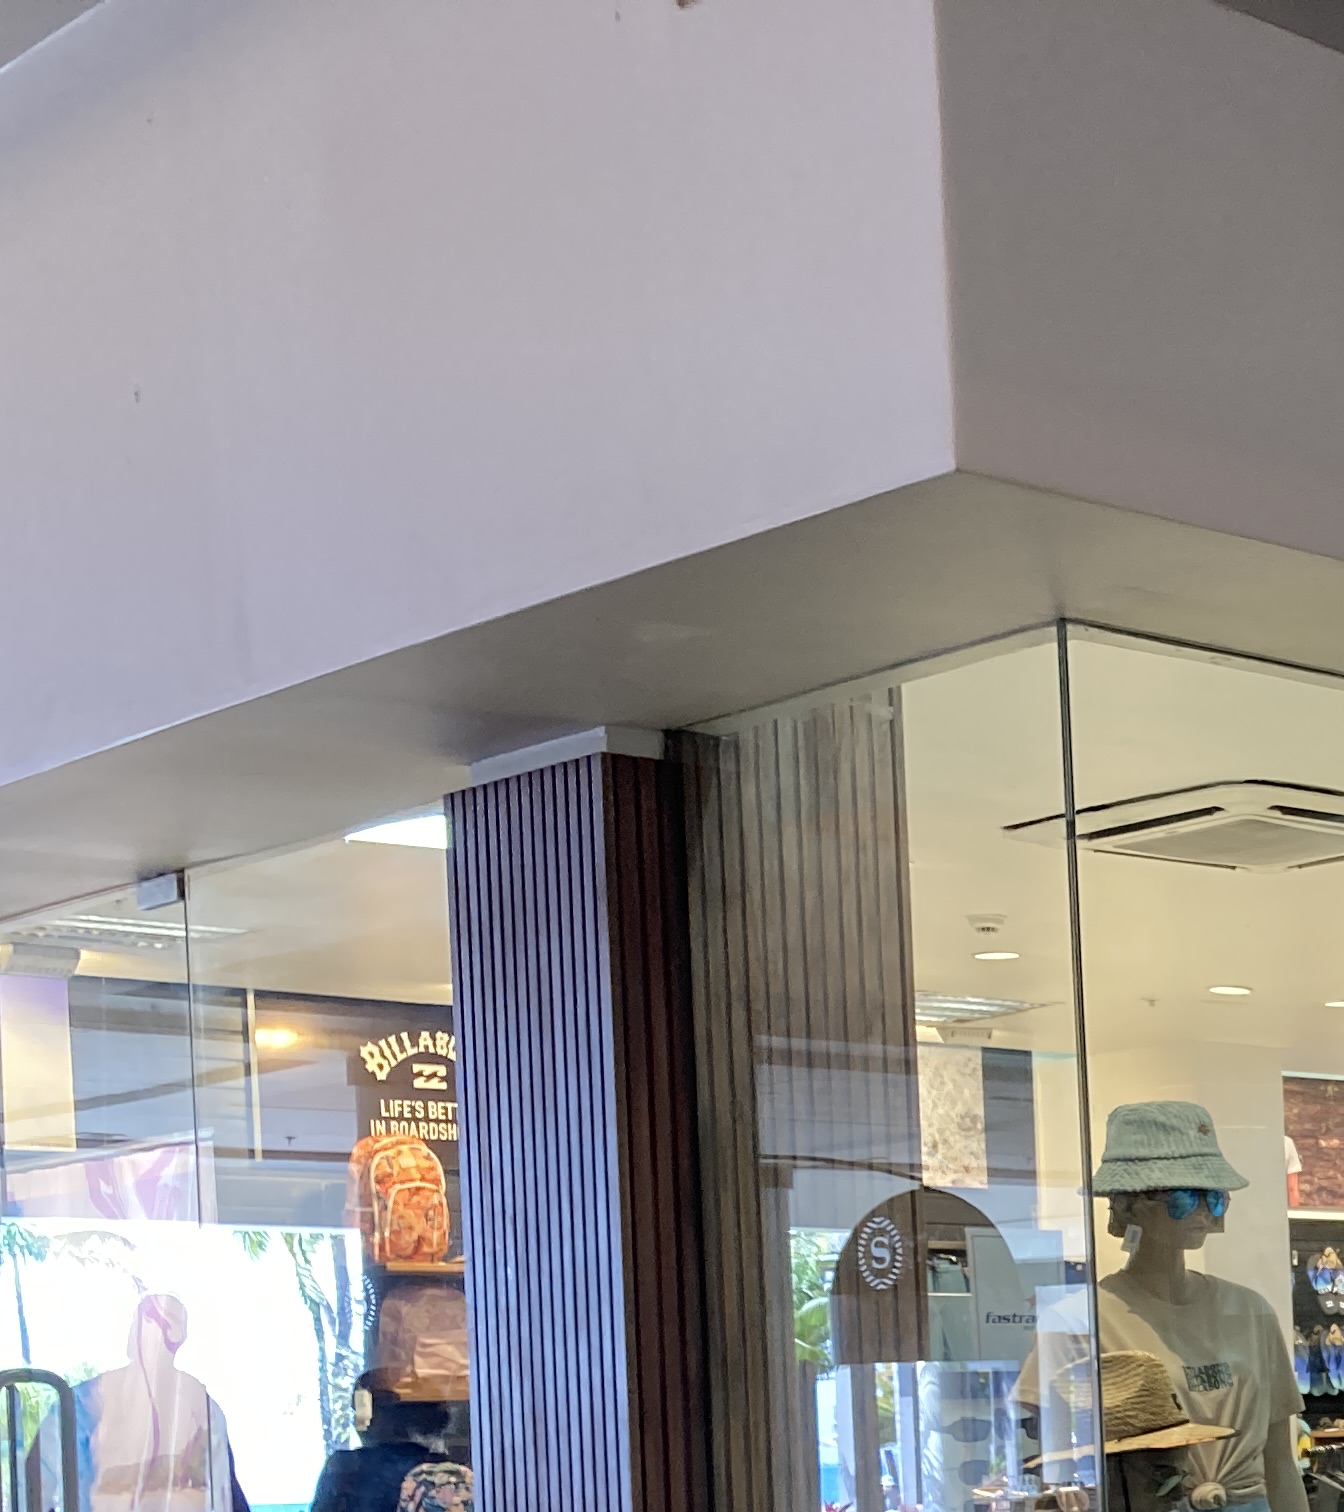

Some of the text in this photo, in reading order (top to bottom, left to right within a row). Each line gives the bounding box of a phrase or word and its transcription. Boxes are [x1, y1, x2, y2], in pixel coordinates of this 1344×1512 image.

[380, 1099, 425, 1118] LIFE'S
[370, 1120, 459, 1141] IN BOARDSH
[870, 1236, 891, 1270] S
[985, 1312, 1037, 1324] fastra
